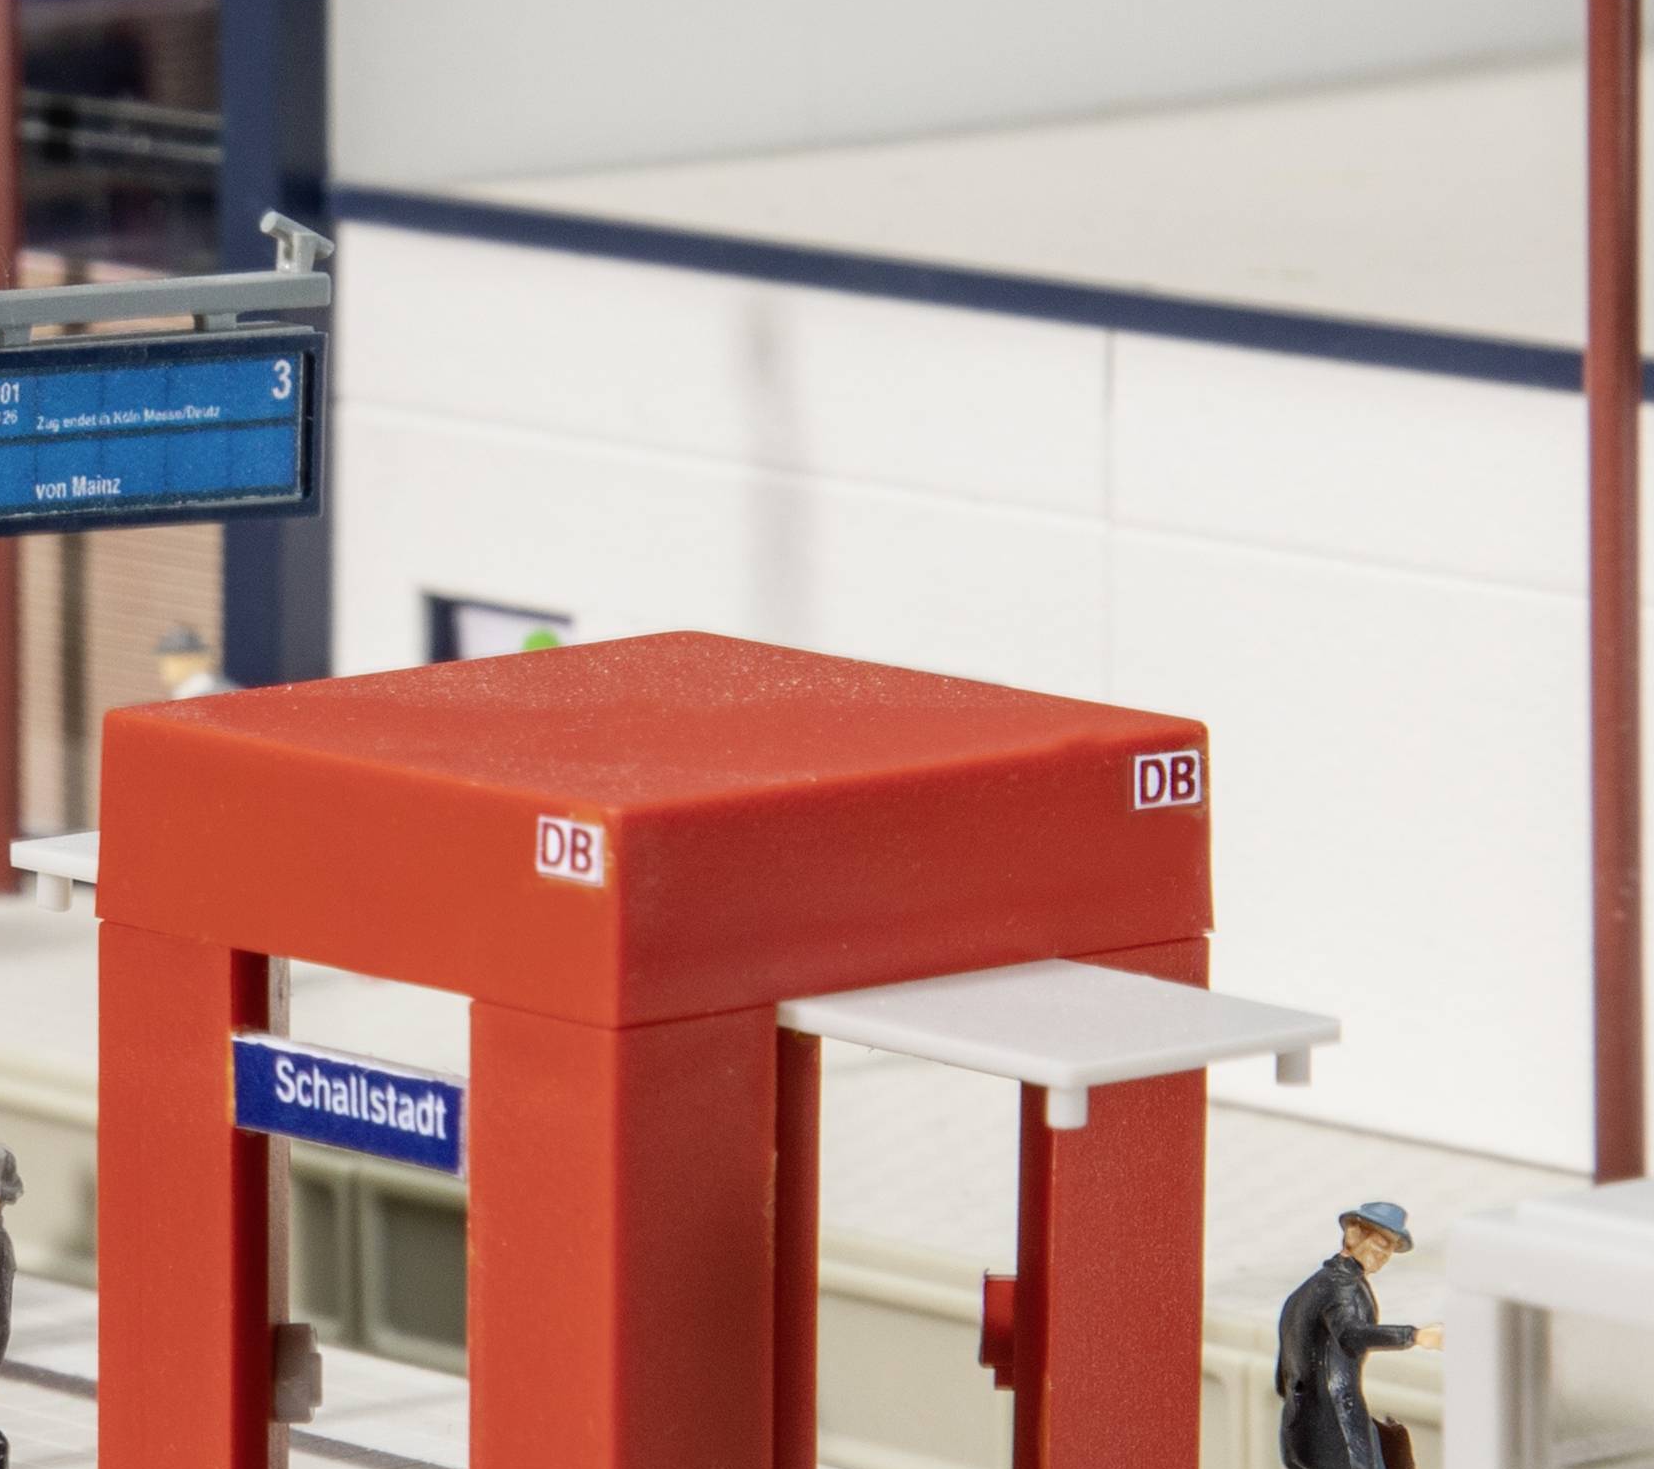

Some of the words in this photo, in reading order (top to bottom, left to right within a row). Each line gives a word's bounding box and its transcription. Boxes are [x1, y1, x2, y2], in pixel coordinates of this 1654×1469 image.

[271, 359, 292, 400] 3
[36, 415, 60, 432] Zug
[62, 412, 96, 429] endet
[35, 481, 67, 500] von
[72, 475, 122, 498] Mainz
[1140, 754, 1196, 805] DB
[541, 822, 593, 872] DB
[274, 1055, 448, 1140] Schallstadt
